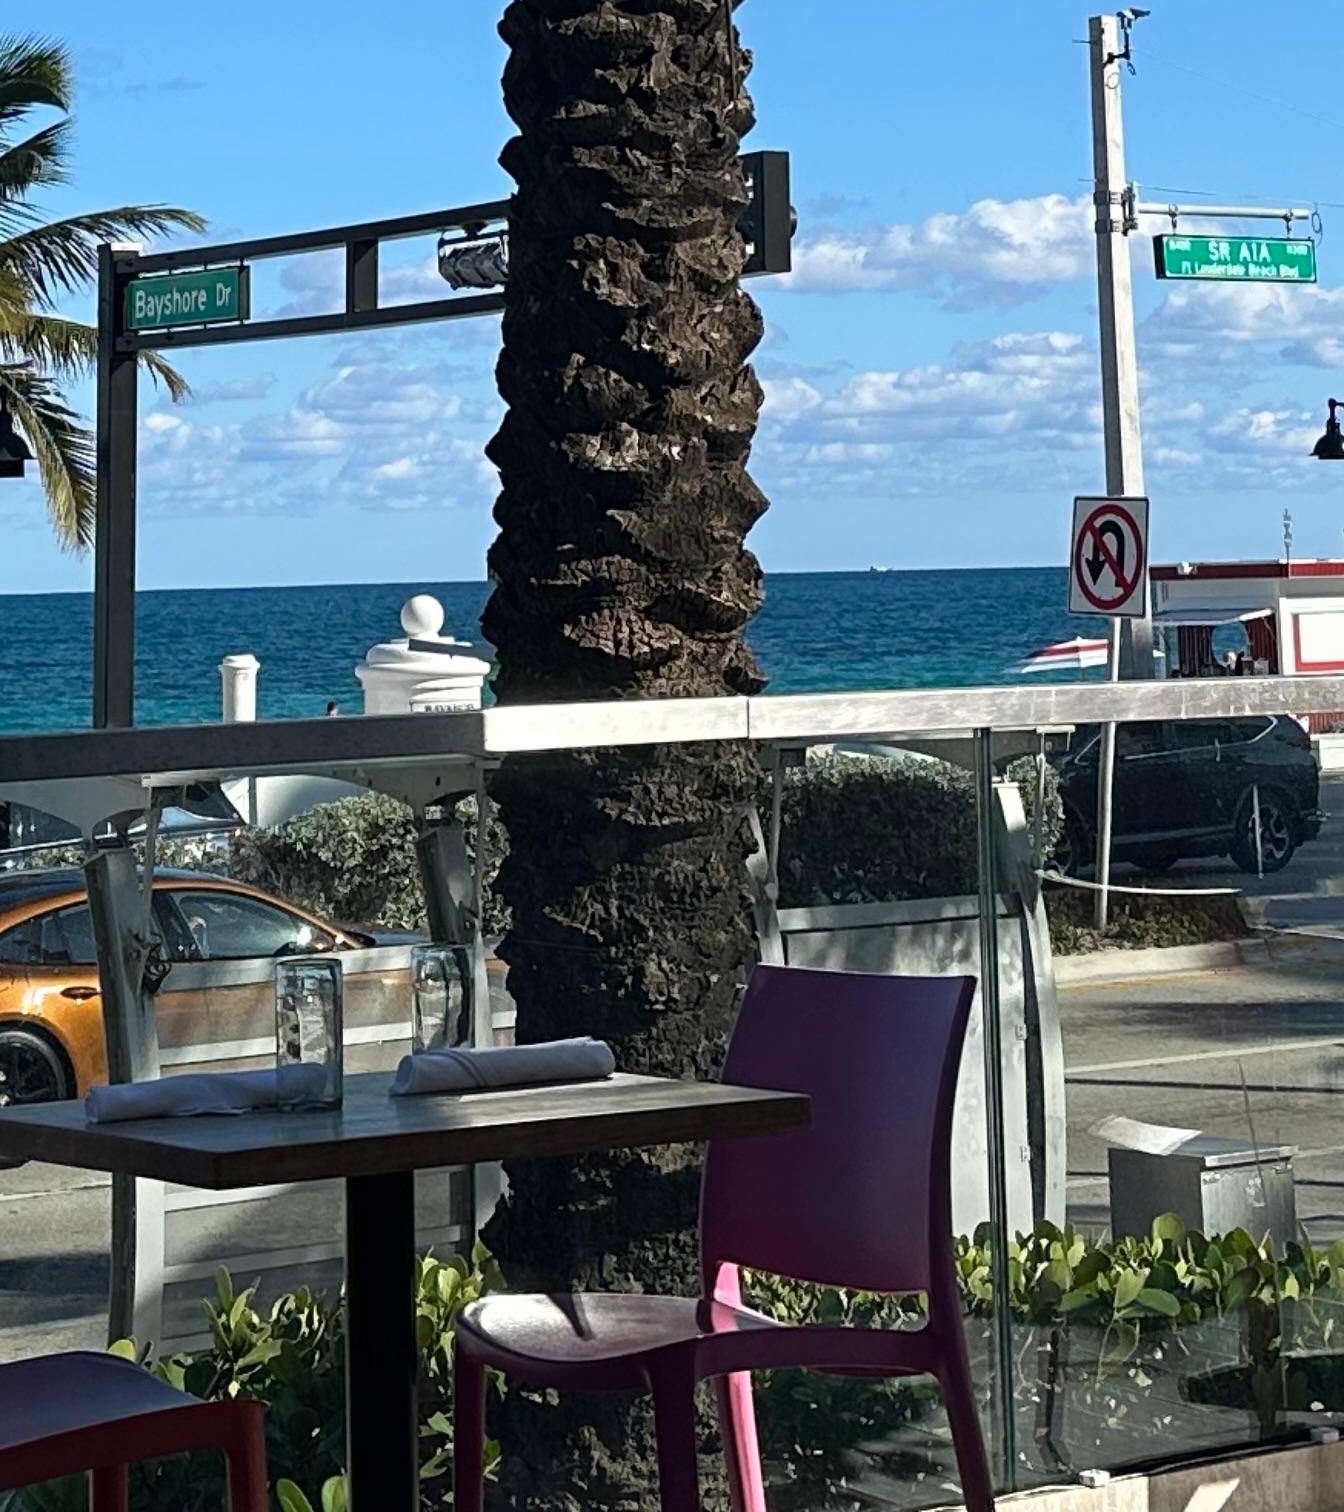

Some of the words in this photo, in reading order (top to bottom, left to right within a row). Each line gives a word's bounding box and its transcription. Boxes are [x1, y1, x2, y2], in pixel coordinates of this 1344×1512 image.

[1208, 240, 1231, 261] SR
[1239, 241, 1272, 263] A1A
[135, 288, 207, 325] Bayshore
[216, 282, 232, 307] Dr
